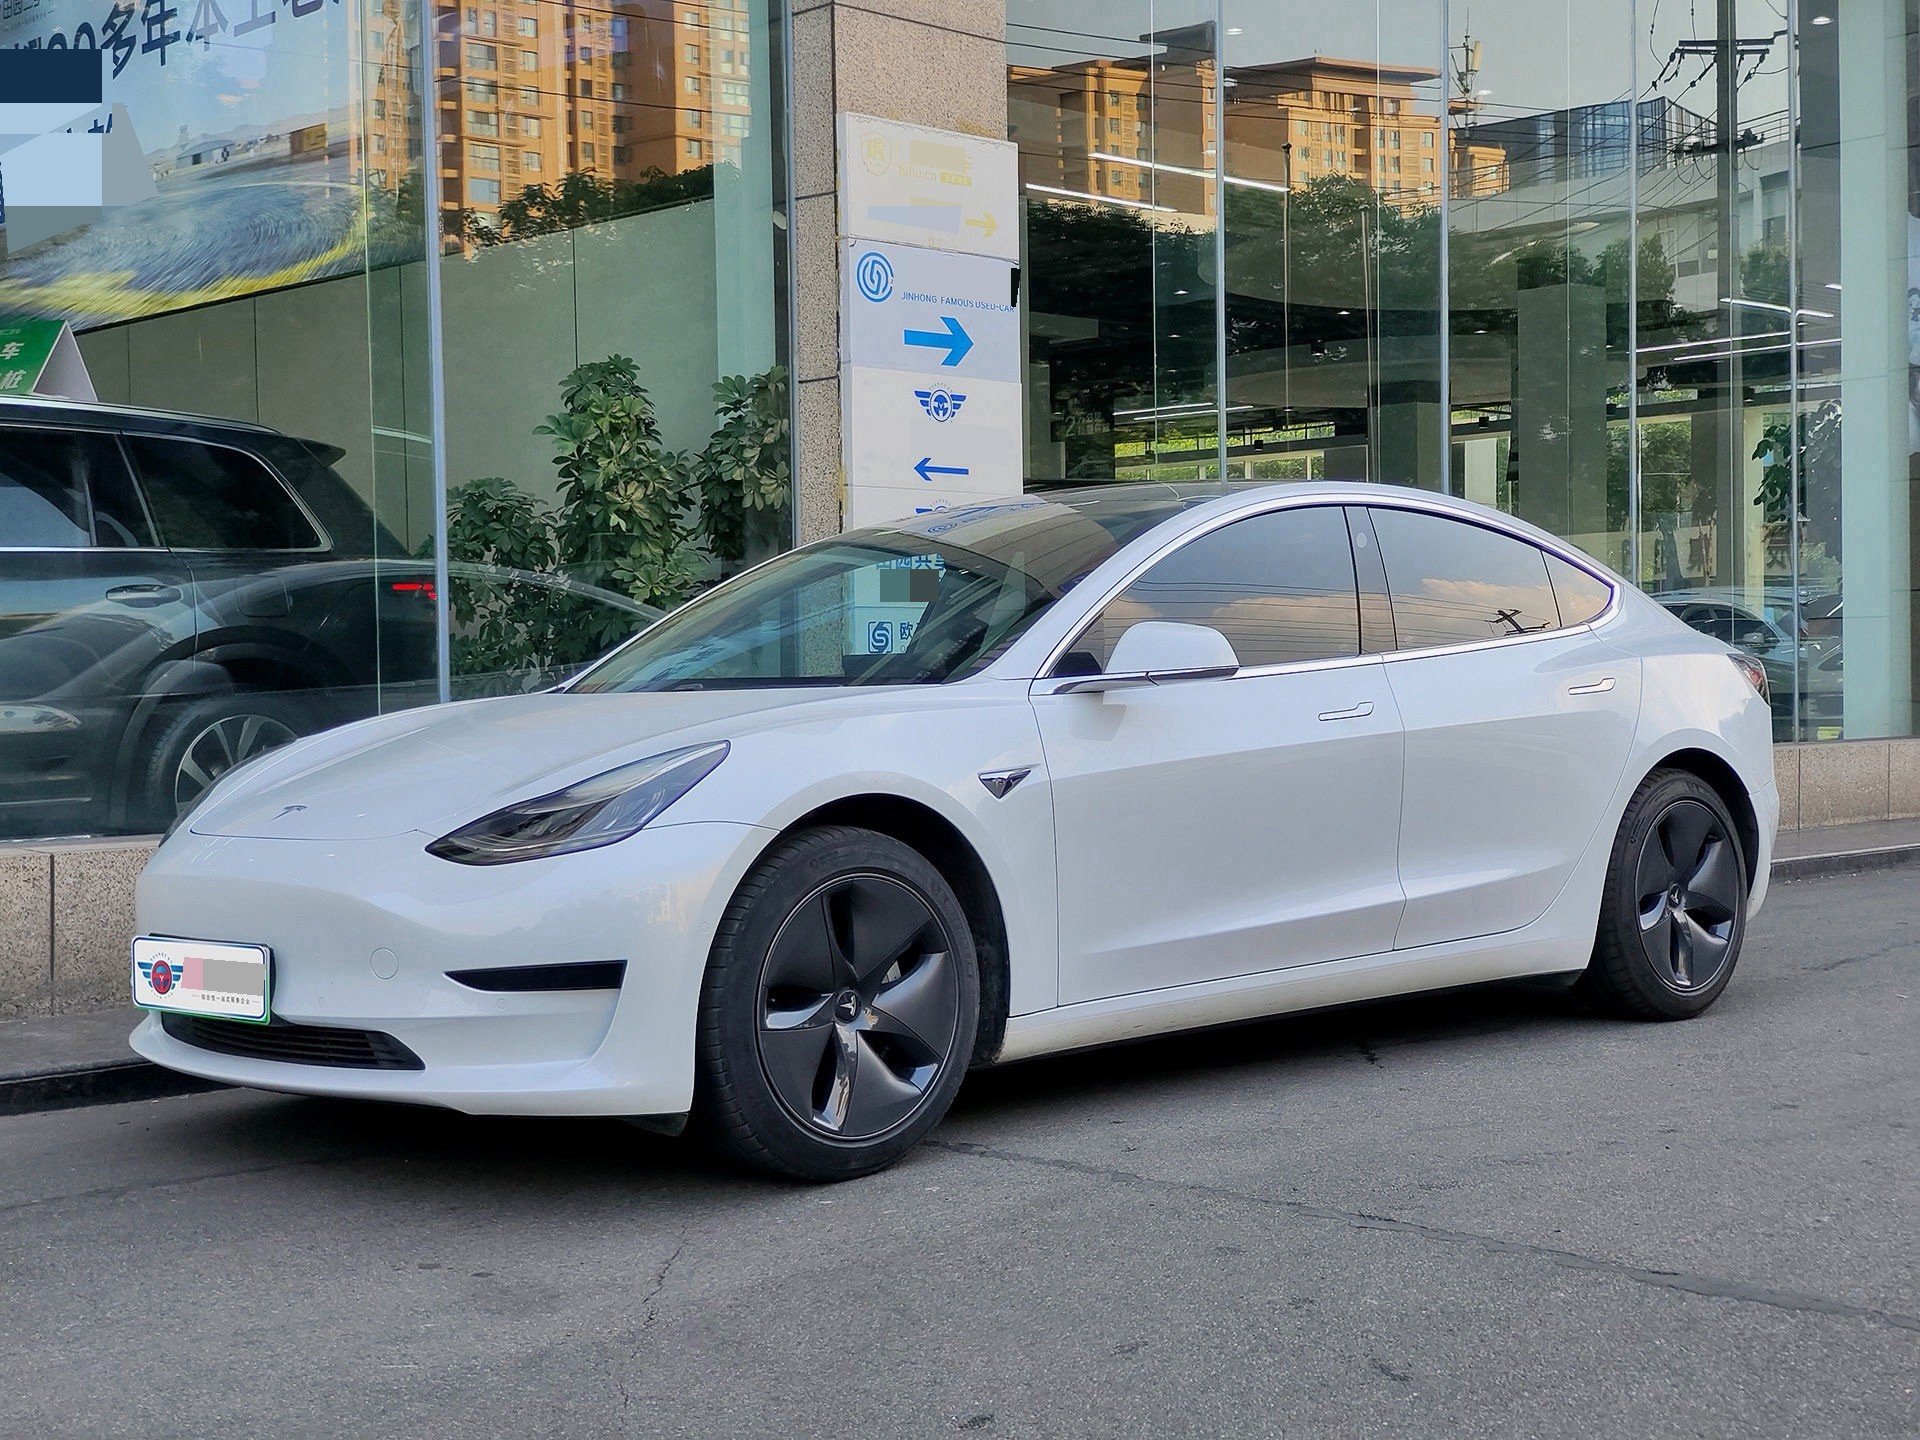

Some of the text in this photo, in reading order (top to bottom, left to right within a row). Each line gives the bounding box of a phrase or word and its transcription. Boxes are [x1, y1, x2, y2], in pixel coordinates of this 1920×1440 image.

[902, 291, 1015, 313] JINHONG FAMOUS USED-CAR
